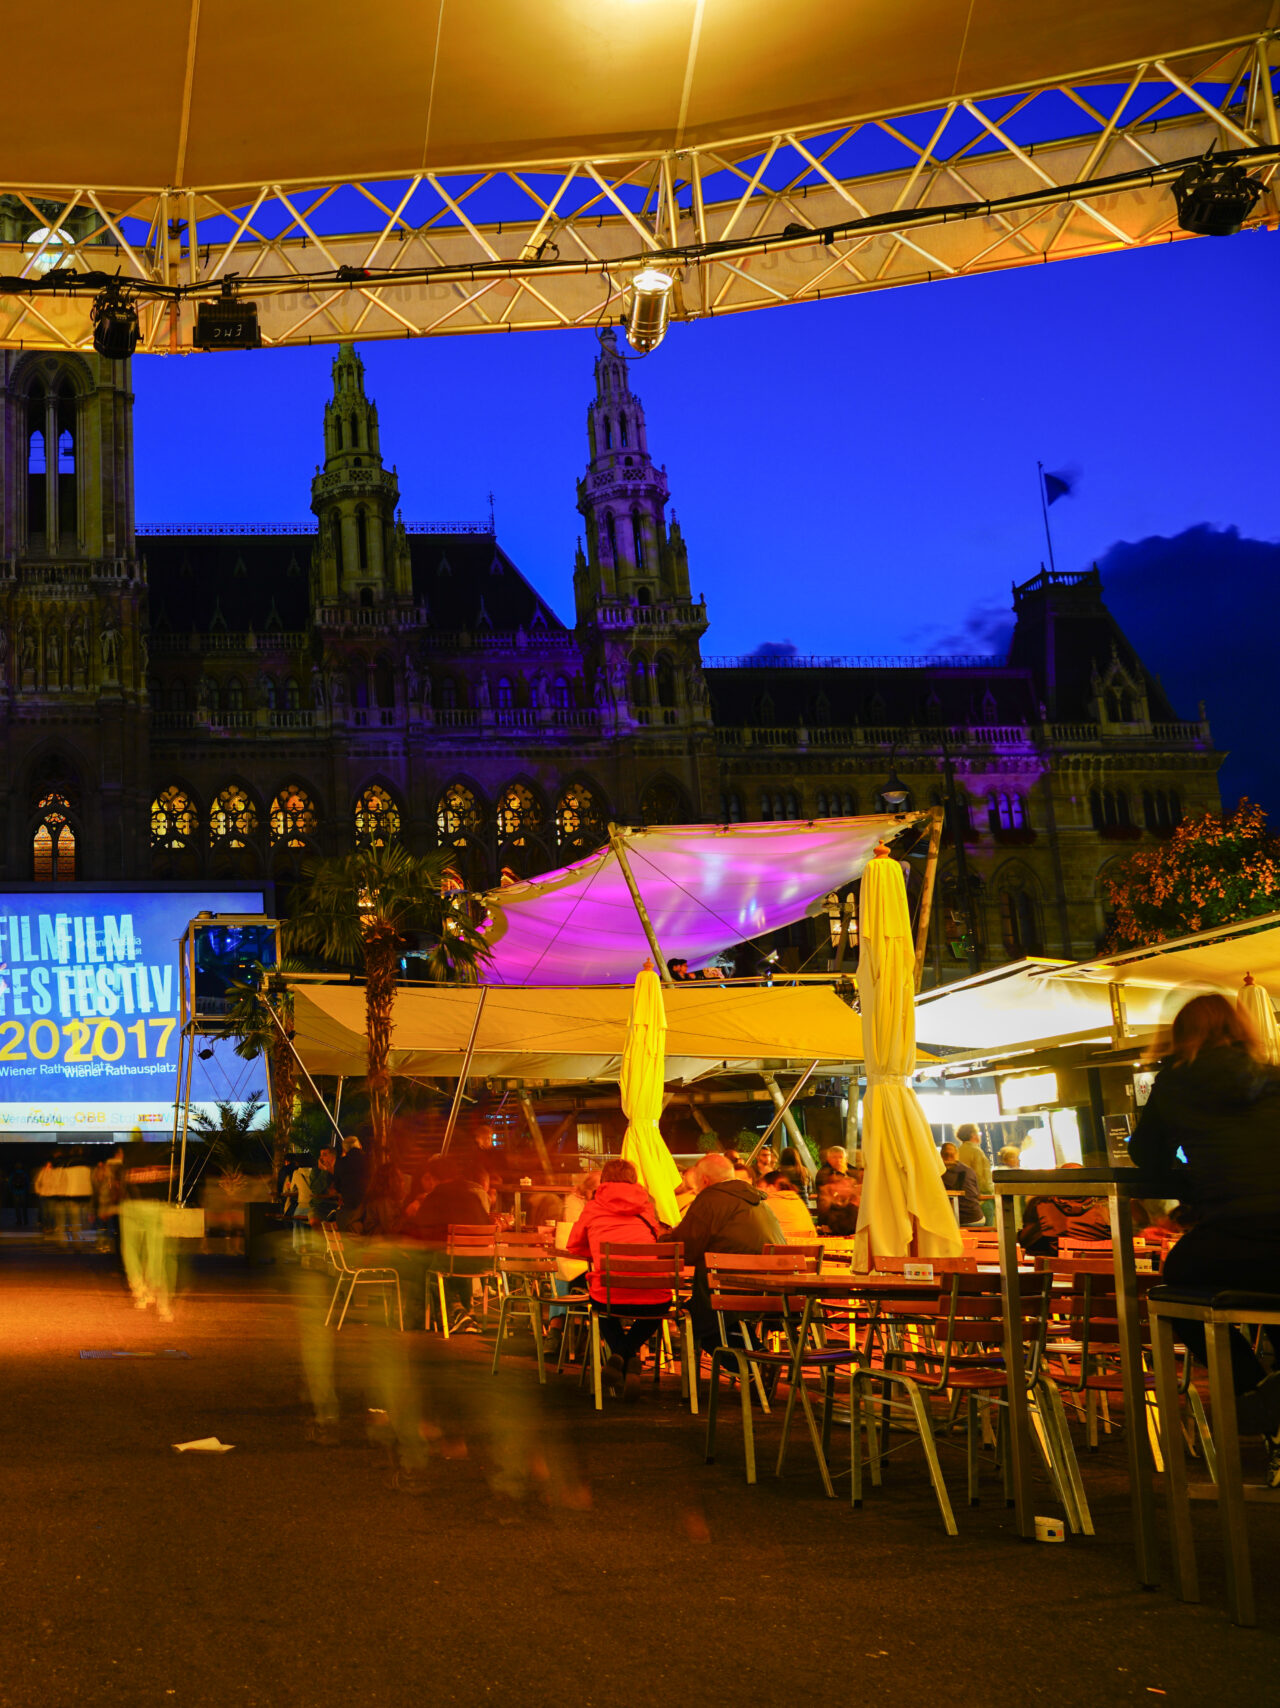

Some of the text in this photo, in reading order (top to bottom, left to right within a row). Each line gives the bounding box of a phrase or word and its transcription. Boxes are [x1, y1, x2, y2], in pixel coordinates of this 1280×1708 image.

[55, 913, 136, 964] FILM
[61, 1017, 177, 1063] 2017
[106, 1062, 177, 1077] Rathausplatz
